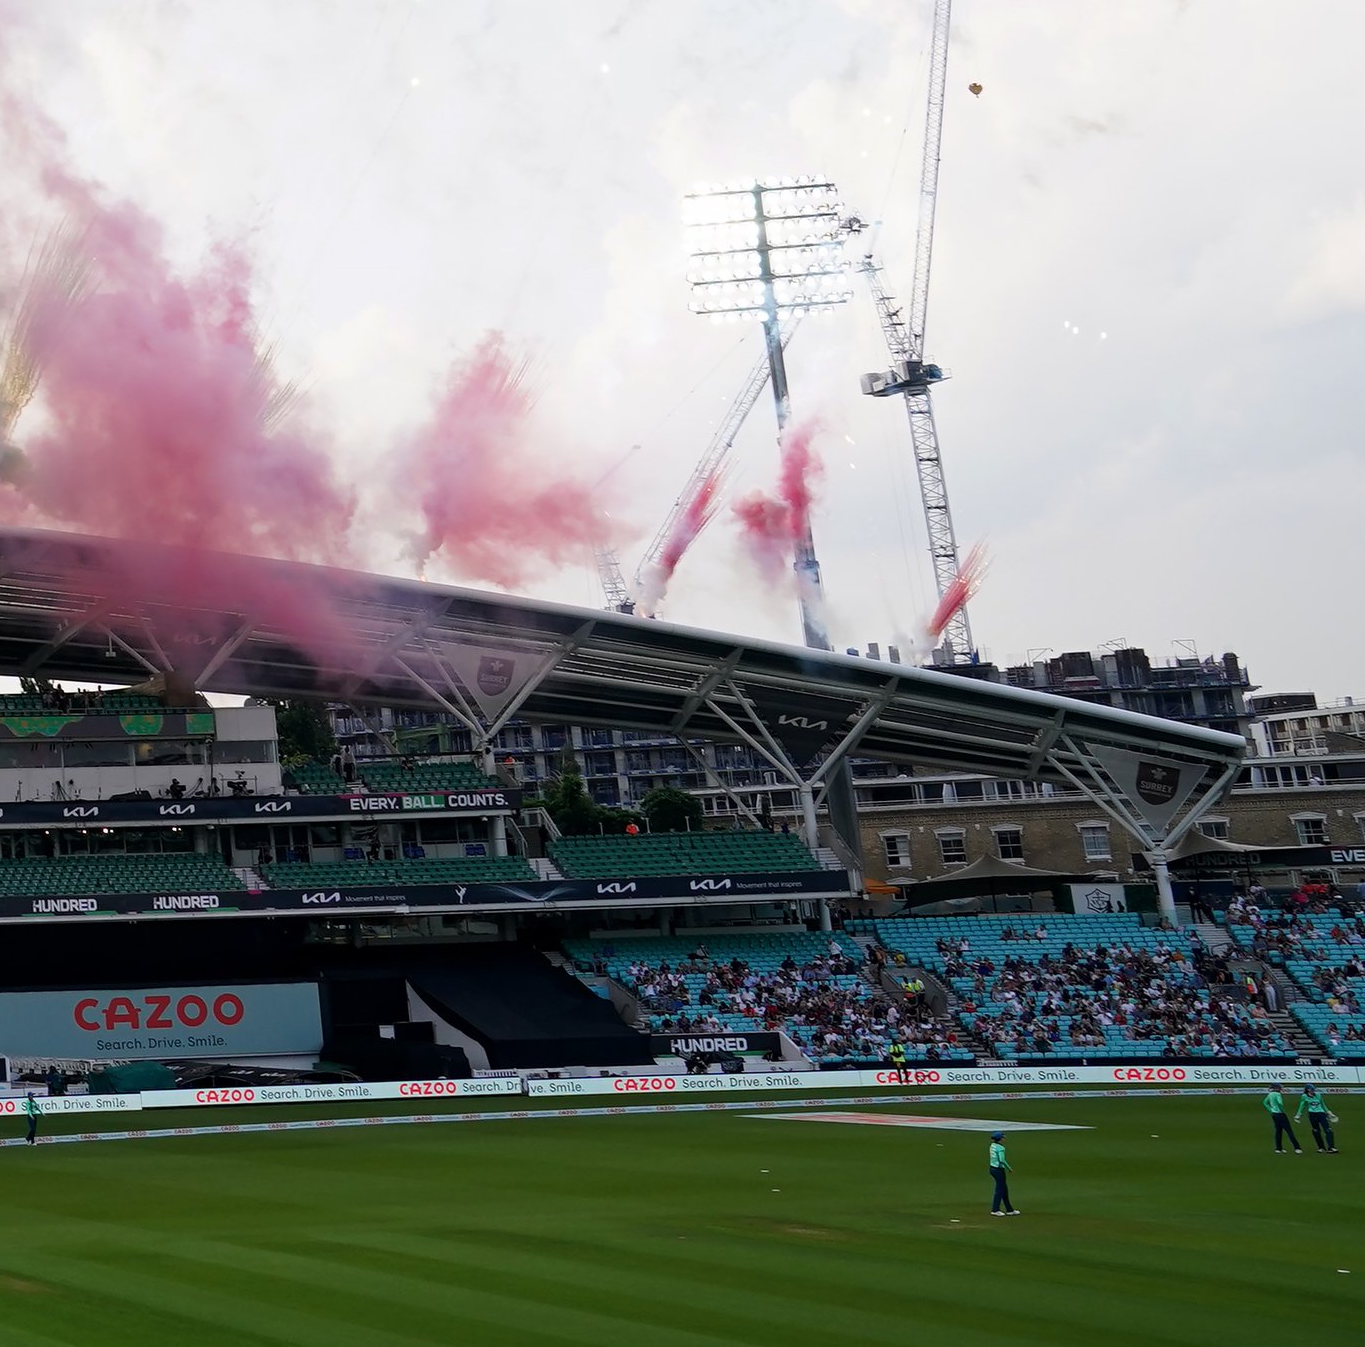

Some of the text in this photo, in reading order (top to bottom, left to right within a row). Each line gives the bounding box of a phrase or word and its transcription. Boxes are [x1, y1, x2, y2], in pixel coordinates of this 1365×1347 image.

[1140, 780, 1174, 794] SURREY
[350, 794, 508, 811] EVERY. BALL. COUNTS.
[32, 898, 97, 913] HUNDRED
[153, 895, 219, 910] HUNDRED
[73, 993, 245, 1031] CAZOO
[96, 1035, 228, 1051] Search. Drive. Smile.
[670, 1037, 748, 1053] HUNDRED
[947, 1070, 992, 1083] Search.
[998, 1070, 1035, 1082] Drive.
[1038, 1069, 1080, 1081] Smile.
[1113, 1068, 1339, 1081] CAZOO Search. Drive. Smile.
[399, 1081, 457, 1096] CAZOO
[462, 1080, 504, 1093] Search.
[549, 1081, 585, 1093] Smile.
[613, 1075, 802, 1092] CAZOO Search. Drive. Smile.
[196, 1084, 372, 1103] CAZOO Search. Drive. Smile.
[63, 1099, 94, 1111] Drive.
[96, 1097, 128, 1108] Smile.
